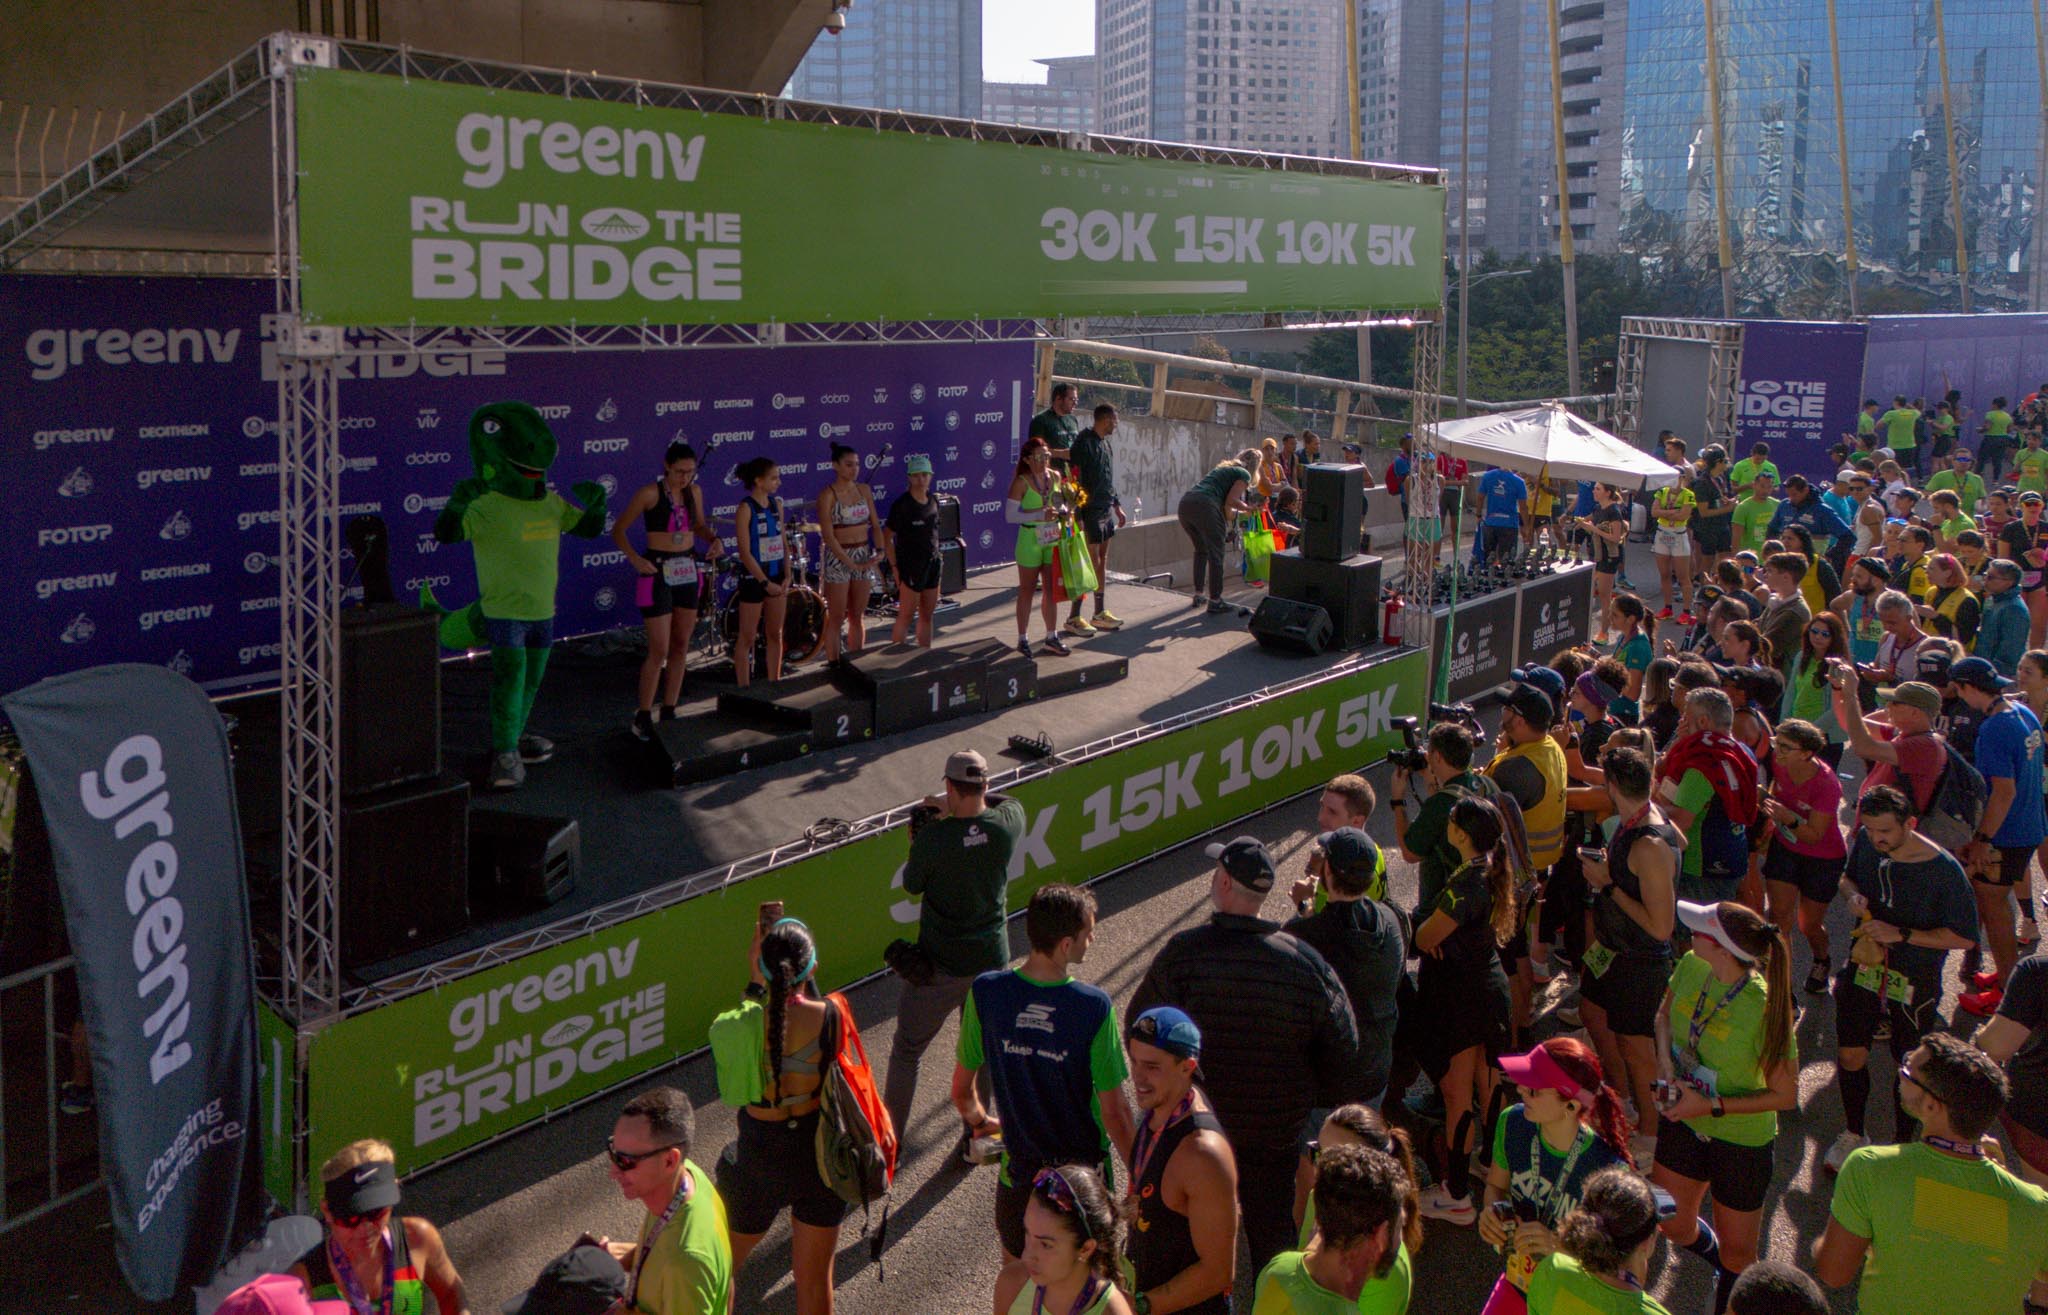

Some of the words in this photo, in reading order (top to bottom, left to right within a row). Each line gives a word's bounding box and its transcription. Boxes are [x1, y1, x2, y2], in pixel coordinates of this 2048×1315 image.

[456, 112, 706, 189] greenv
[410, 196, 569, 237] RUN
[655, 209, 741, 243] THE
[1039, 207, 1158, 262] 30K
[1174, 214, 1265, 264] 15K
[1275, 220, 1359, 266] 10K
[1367, 224, 1417, 266] 5K
[411, 238, 742, 300] BRIDGE
[25, 328, 242, 381] greenv
[1784, 381, 1827, 395] THE
[655, 399, 700, 417] greenv
[138, 423, 210, 439] DECATHLON
[1747, 419, 1763, 428] 01
[1791, 421, 1824, 431] 2024
[1763, 430, 1787, 439] 10K
[32, 426, 116, 450] greenv
[711, 430, 755, 448] greenv
[404, 451, 451, 466] dobro
[136, 465, 213, 490] greenv
[140, 562, 212, 582] DECATHLON
[35, 571, 118, 599] greenv
[137, 602, 214, 632] greenv
[1533, 633, 1556, 651] SPORTS
[1008, 678, 1018, 698] 3
[1079, 672, 1086, 683] 5
[928, 682, 940, 712] 1
[836, 714, 849, 738] 2
[740, 752, 749, 766] 4
[1081, 752, 1204, 852] 15K
[1218, 708, 1326, 798] 10K
[1335, 683, 1399, 750] 5K
[80, 734, 194, 1085] greenv
[448, 938, 640, 1053] greenv
[414, 1034, 533, 1101] RUN
[597, 981, 667, 1025] THE
[413, 1007, 666, 1148] BRIDGE
